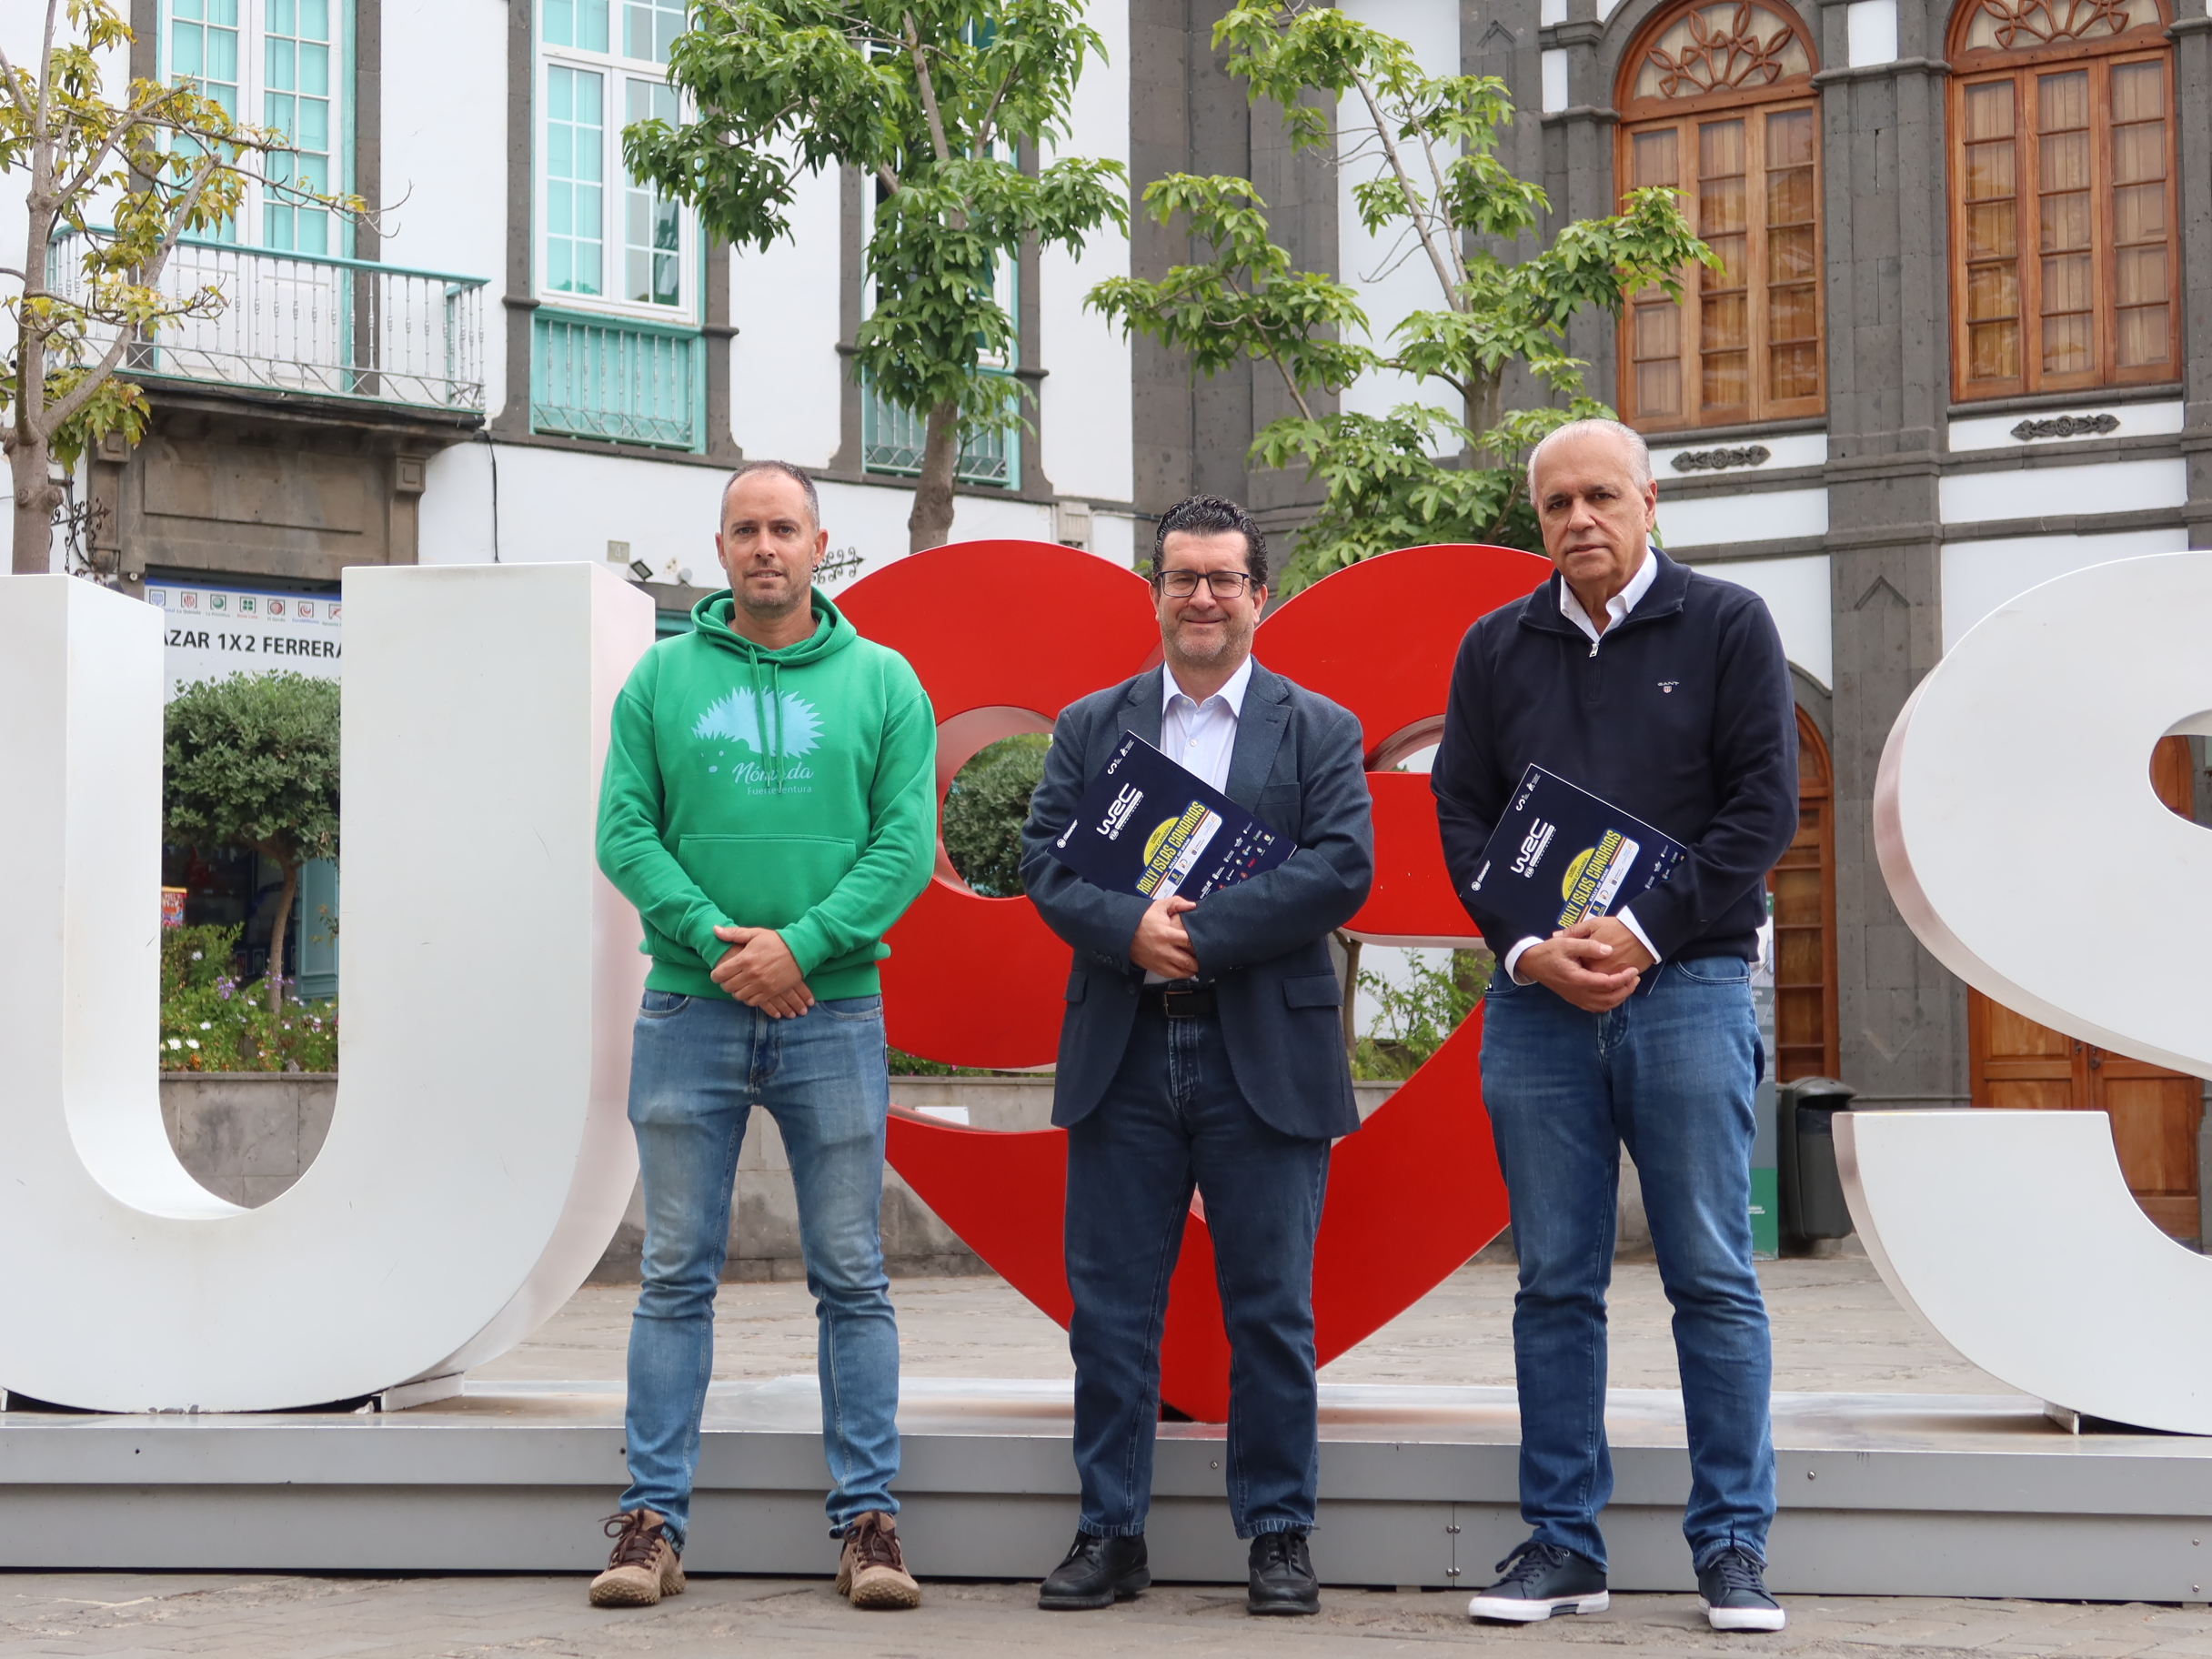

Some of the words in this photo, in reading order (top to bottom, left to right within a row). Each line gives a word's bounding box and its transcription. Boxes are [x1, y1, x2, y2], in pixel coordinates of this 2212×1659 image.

[1095, 782, 1137, 836] WRC
[1136, 868, 1161, 895] RALLY
[1151, 843, 1177, 873] ISLAS
[1167, 799, 1206, 849] CANARIAS
[1168, 856, 1178, 869] RALLY
[1181, 838, 1191, 850] SPAIN
[1510, 817, 1548, 874] WRC
[1558, 902, 1582, 928] RALLY
[1571, 875, 1596, 907] ISLAS
[1585, 829, 1622, 880] CANARIAS
[1600, 868, 1609, 881] SPAIN
